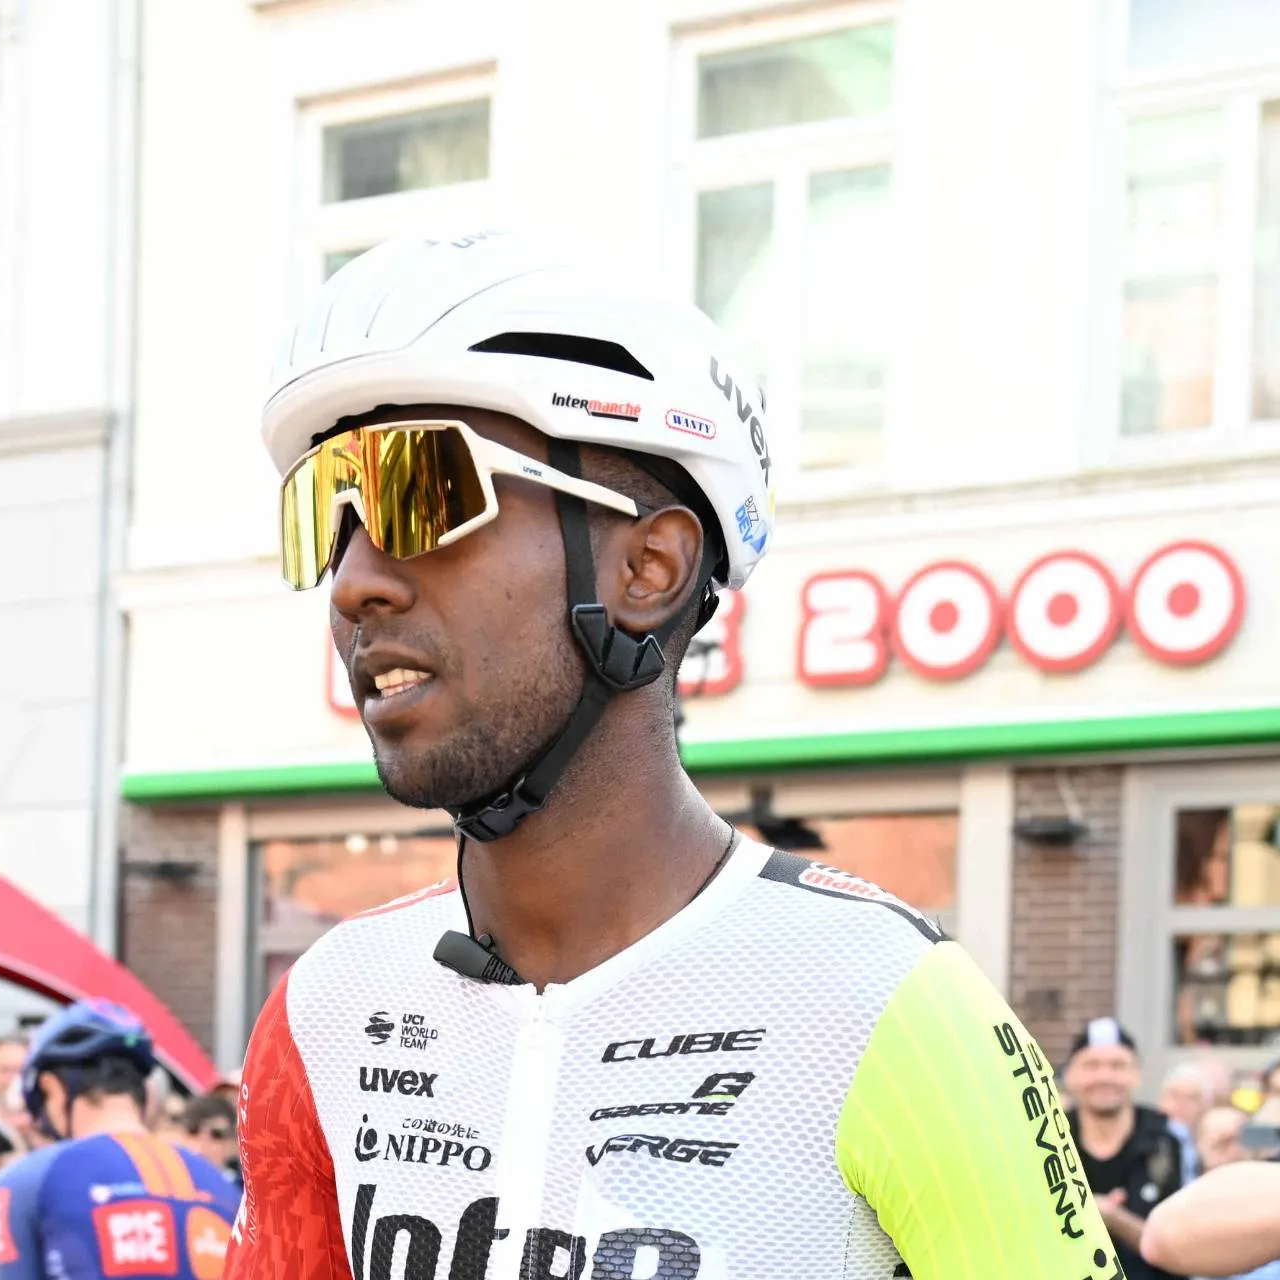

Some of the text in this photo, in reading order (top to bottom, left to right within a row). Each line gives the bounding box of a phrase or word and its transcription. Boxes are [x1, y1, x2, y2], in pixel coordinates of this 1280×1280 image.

[672, 414, 711, 434] WANTY
[735, 506, 753, 544] DEV
[744, 495, 761, 527] BIZZ
[800, 540, 1246, 690] 2000
[401, 1025, 438, 1040] WORLD
[403, 1013, 425, 1026] UCI
[400, 1037, 427, 1050] TEAM
[601, 1028, 767, 1064] CUBE
[360, 1066, 439, 1098] uvex
[402, 1117, 480, 1140] この道の先に
[993, 1022, 1085, 1239] STEVENY
[1027, 1043, 1087, 1209] SKODA
[383, 1133, 492, 1172] NIPPO
[585, 1133, 740, 1168] VERGE
